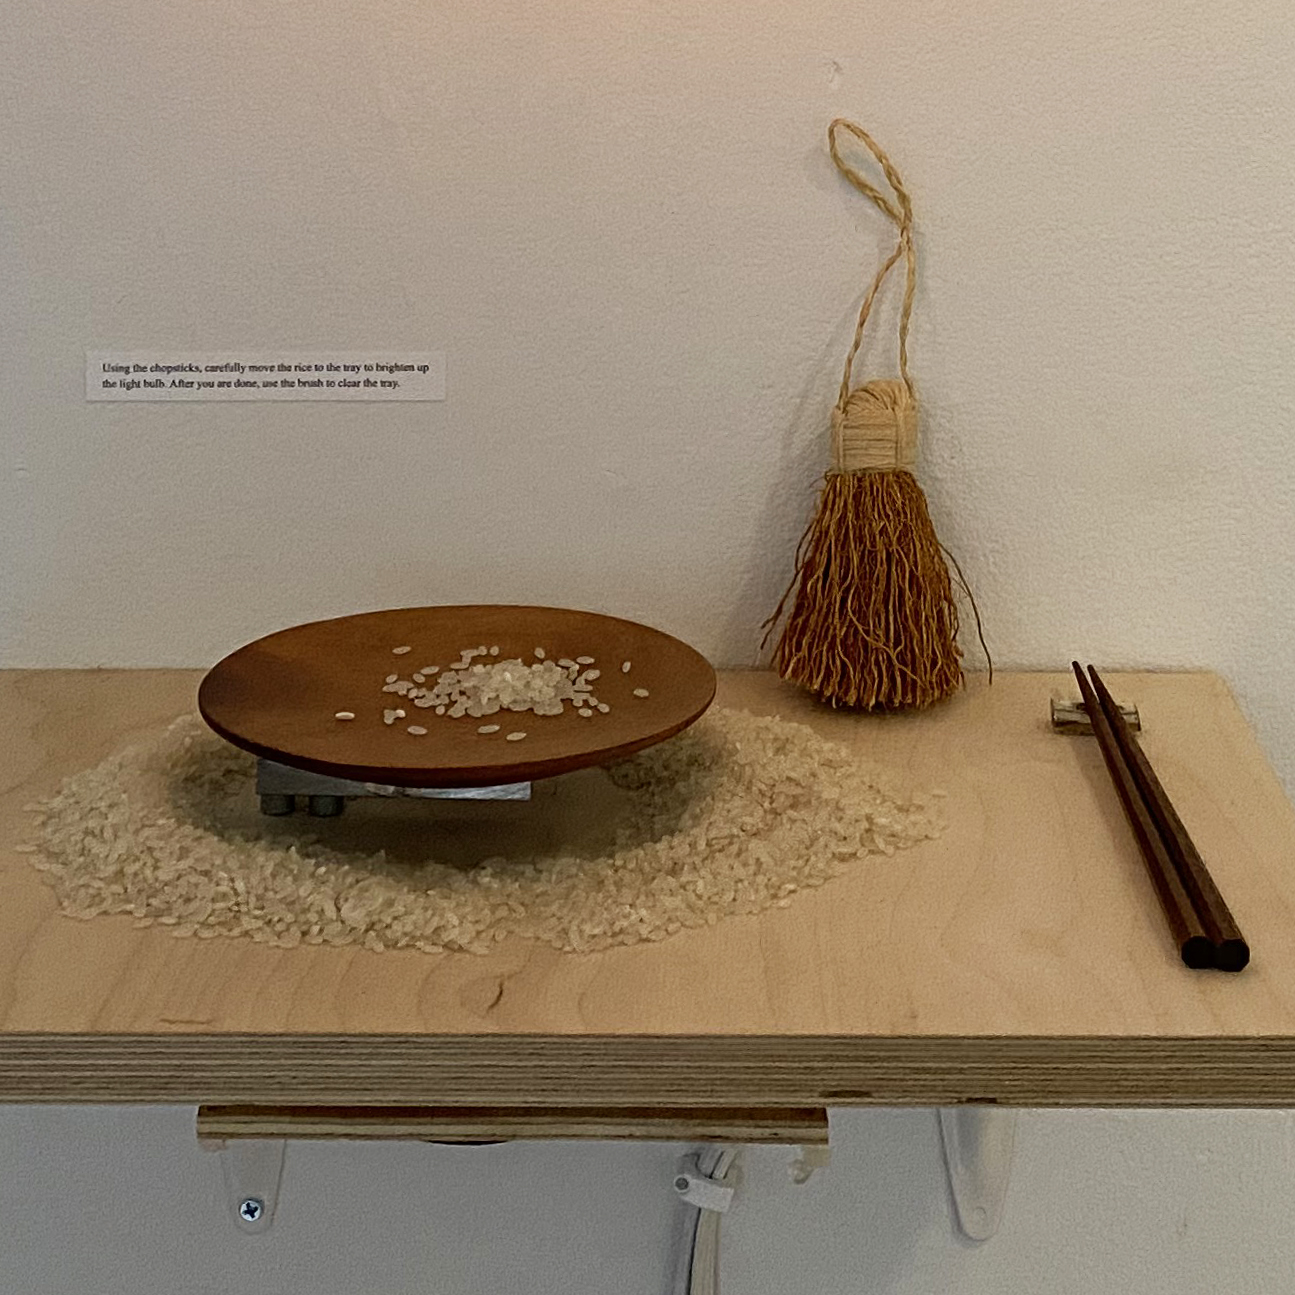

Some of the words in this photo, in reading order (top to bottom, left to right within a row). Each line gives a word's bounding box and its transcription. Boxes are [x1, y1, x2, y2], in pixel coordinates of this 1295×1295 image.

[103, 362, 132, 376] Using
[133, 363, 148, 374] the
[150, 362, 202, 376] chopsticks,
[204, 361, 247, 375] carefully
[248, 364, 275, 373] move
[277, 362, 292, 373] the
[294, 362, 313, 373] rice
[314, 363, 324, 373] to
[326, 362, 341, 373] the
[343, 363, 362, 375] tray
[364, 363, 374, 373] to
[376, 361, 415, 375] brighten
[417, 364, 429, 375] up
[102, 378, 117, 389] the
[120, 378, 141, 392] light
[143, 378, 167, 389] bulb.
[168, 378, 195, 389] After
[196, 380, 215, 391] you
[217, 380, 232, 389] are
[234, 378, 260, 390] done,
[262, 380, 278, 389] use
[280, 377, 295, 389] the
[297, 377, 324, 388] brush
[326, 379, 336, 388] to
[338, 377, 361, 389] clear
[363, 377, 378, 388] the
[380, 379, 400, 390] tray.
